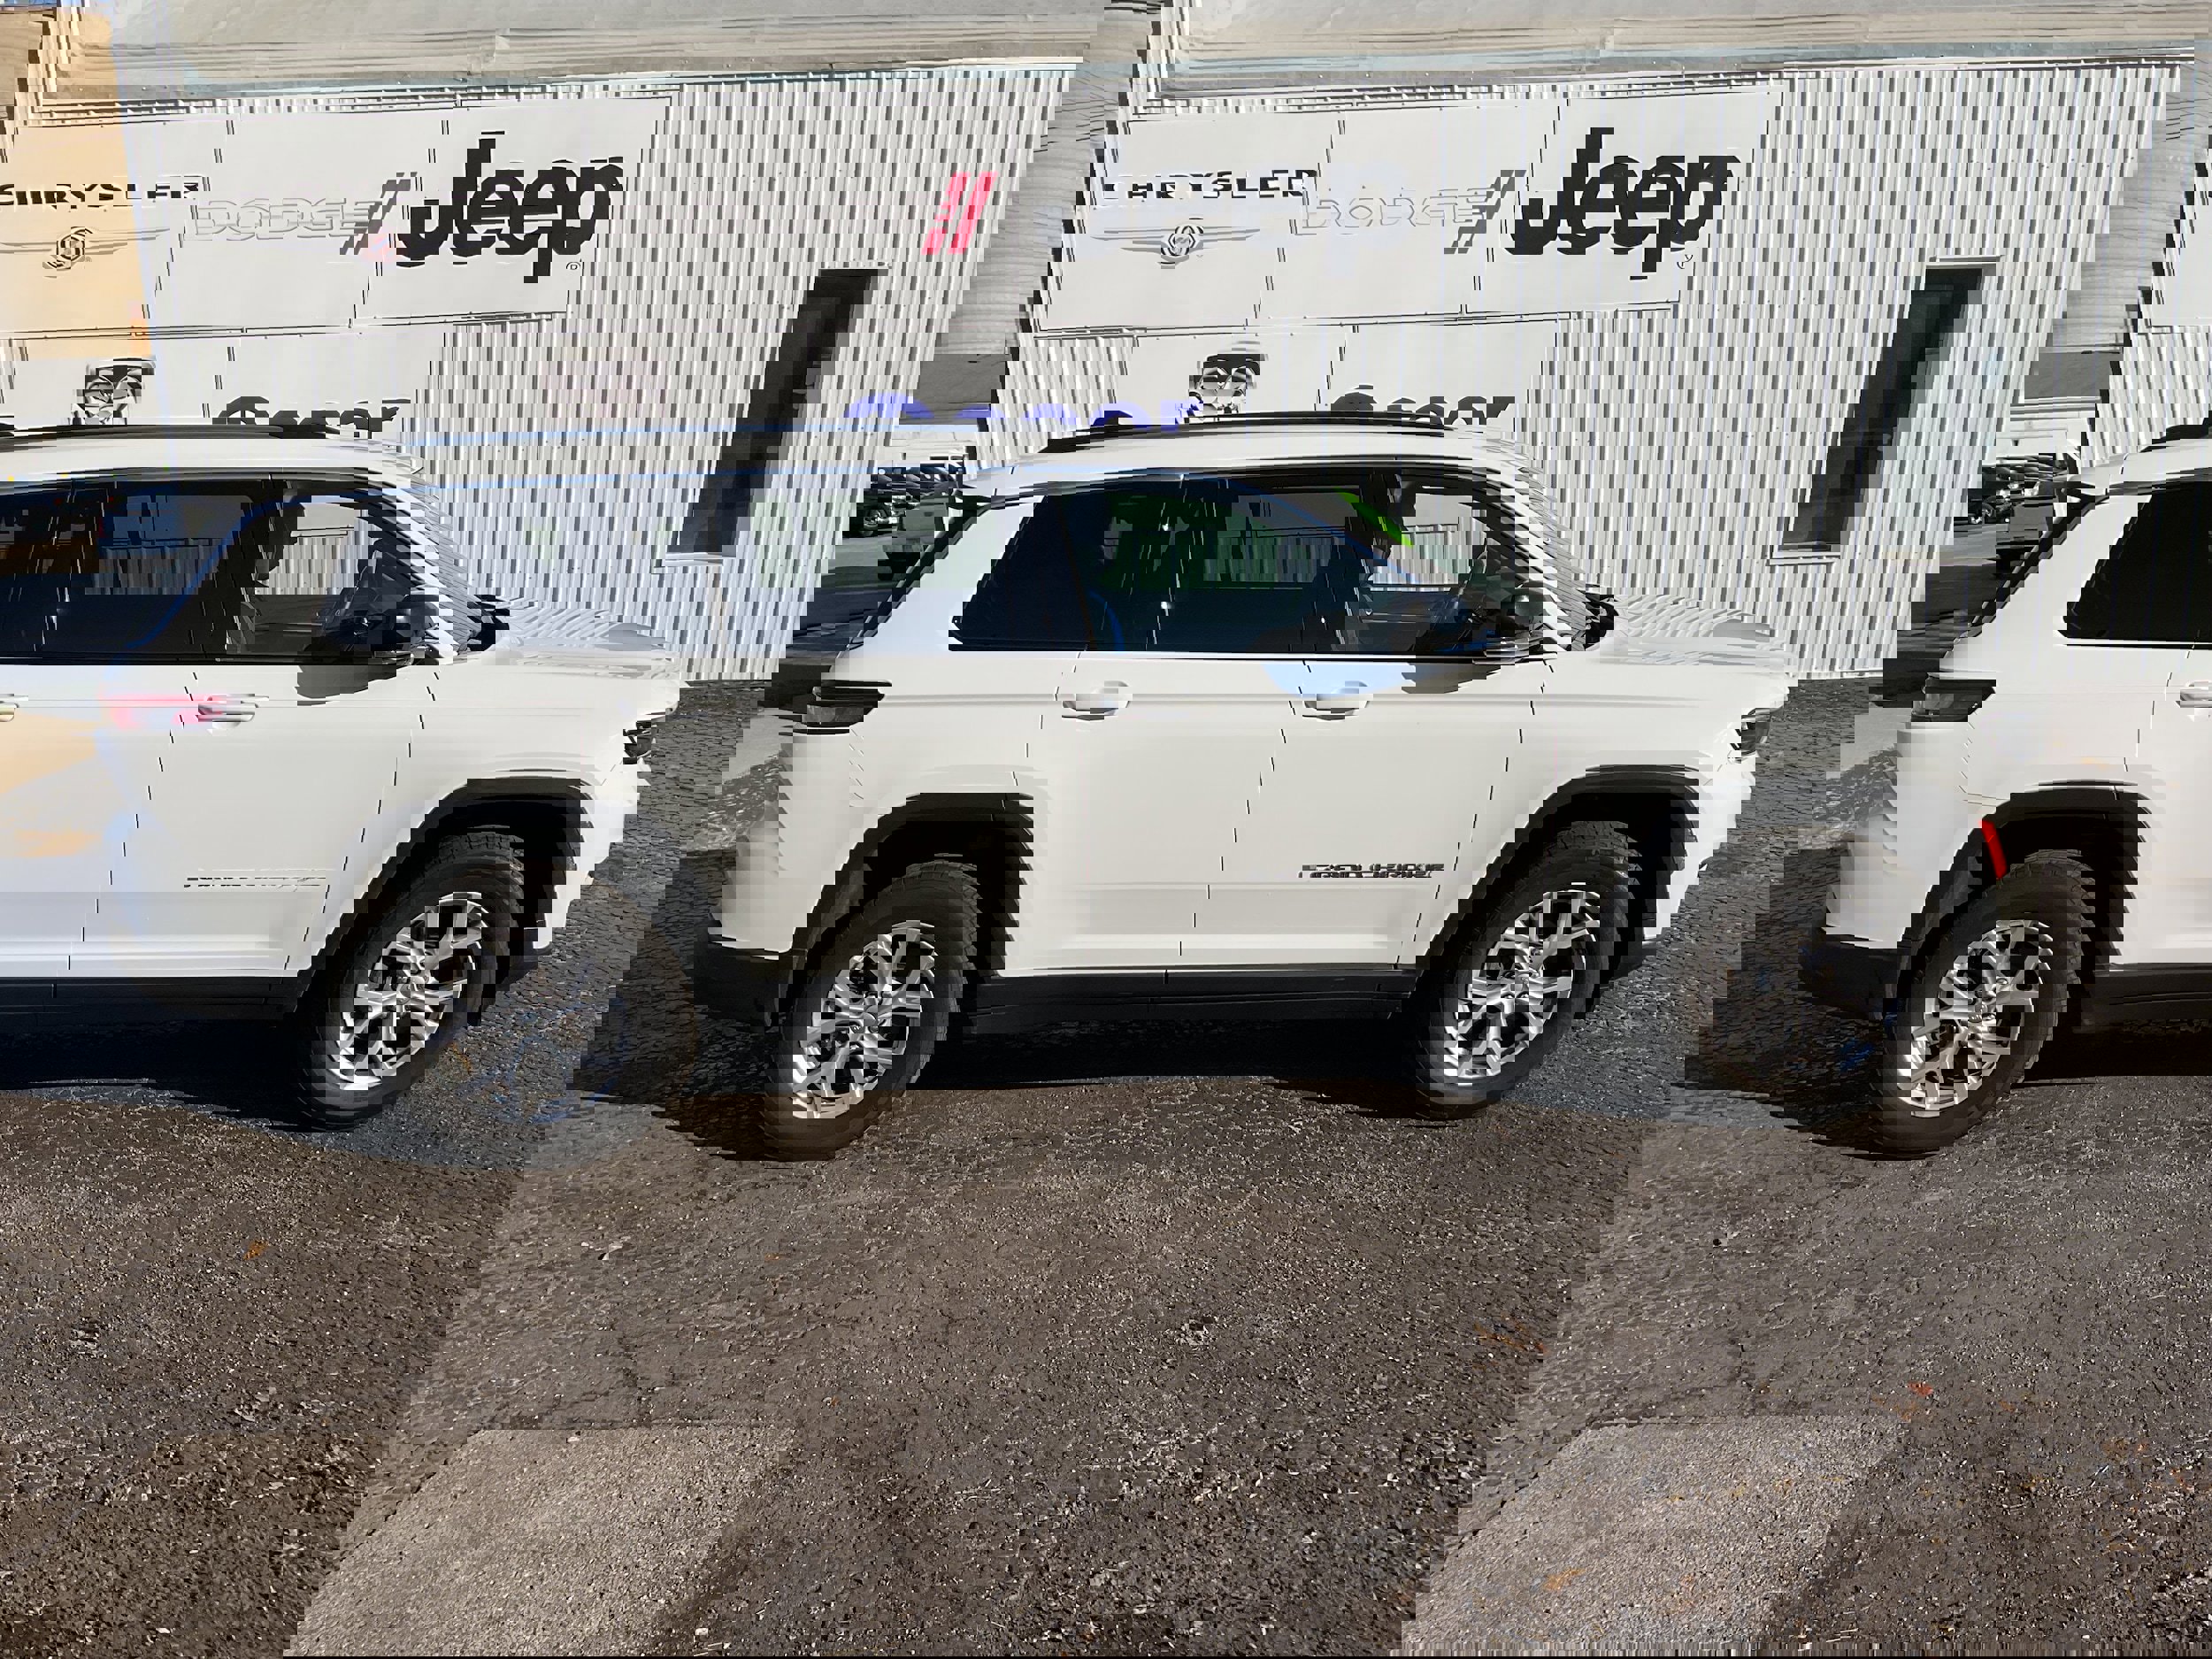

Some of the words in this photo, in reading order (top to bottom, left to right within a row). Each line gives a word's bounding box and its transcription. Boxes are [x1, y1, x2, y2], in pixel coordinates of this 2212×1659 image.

[396, 130, 624, 283] Jeep
[1102, 170, 1317, 199] CHRYSLER
[1503, 127, 1740, 280] Jeep
[195, 197, 382, 241] DODGE
[1297, 188, 1495, 235] DODGE
